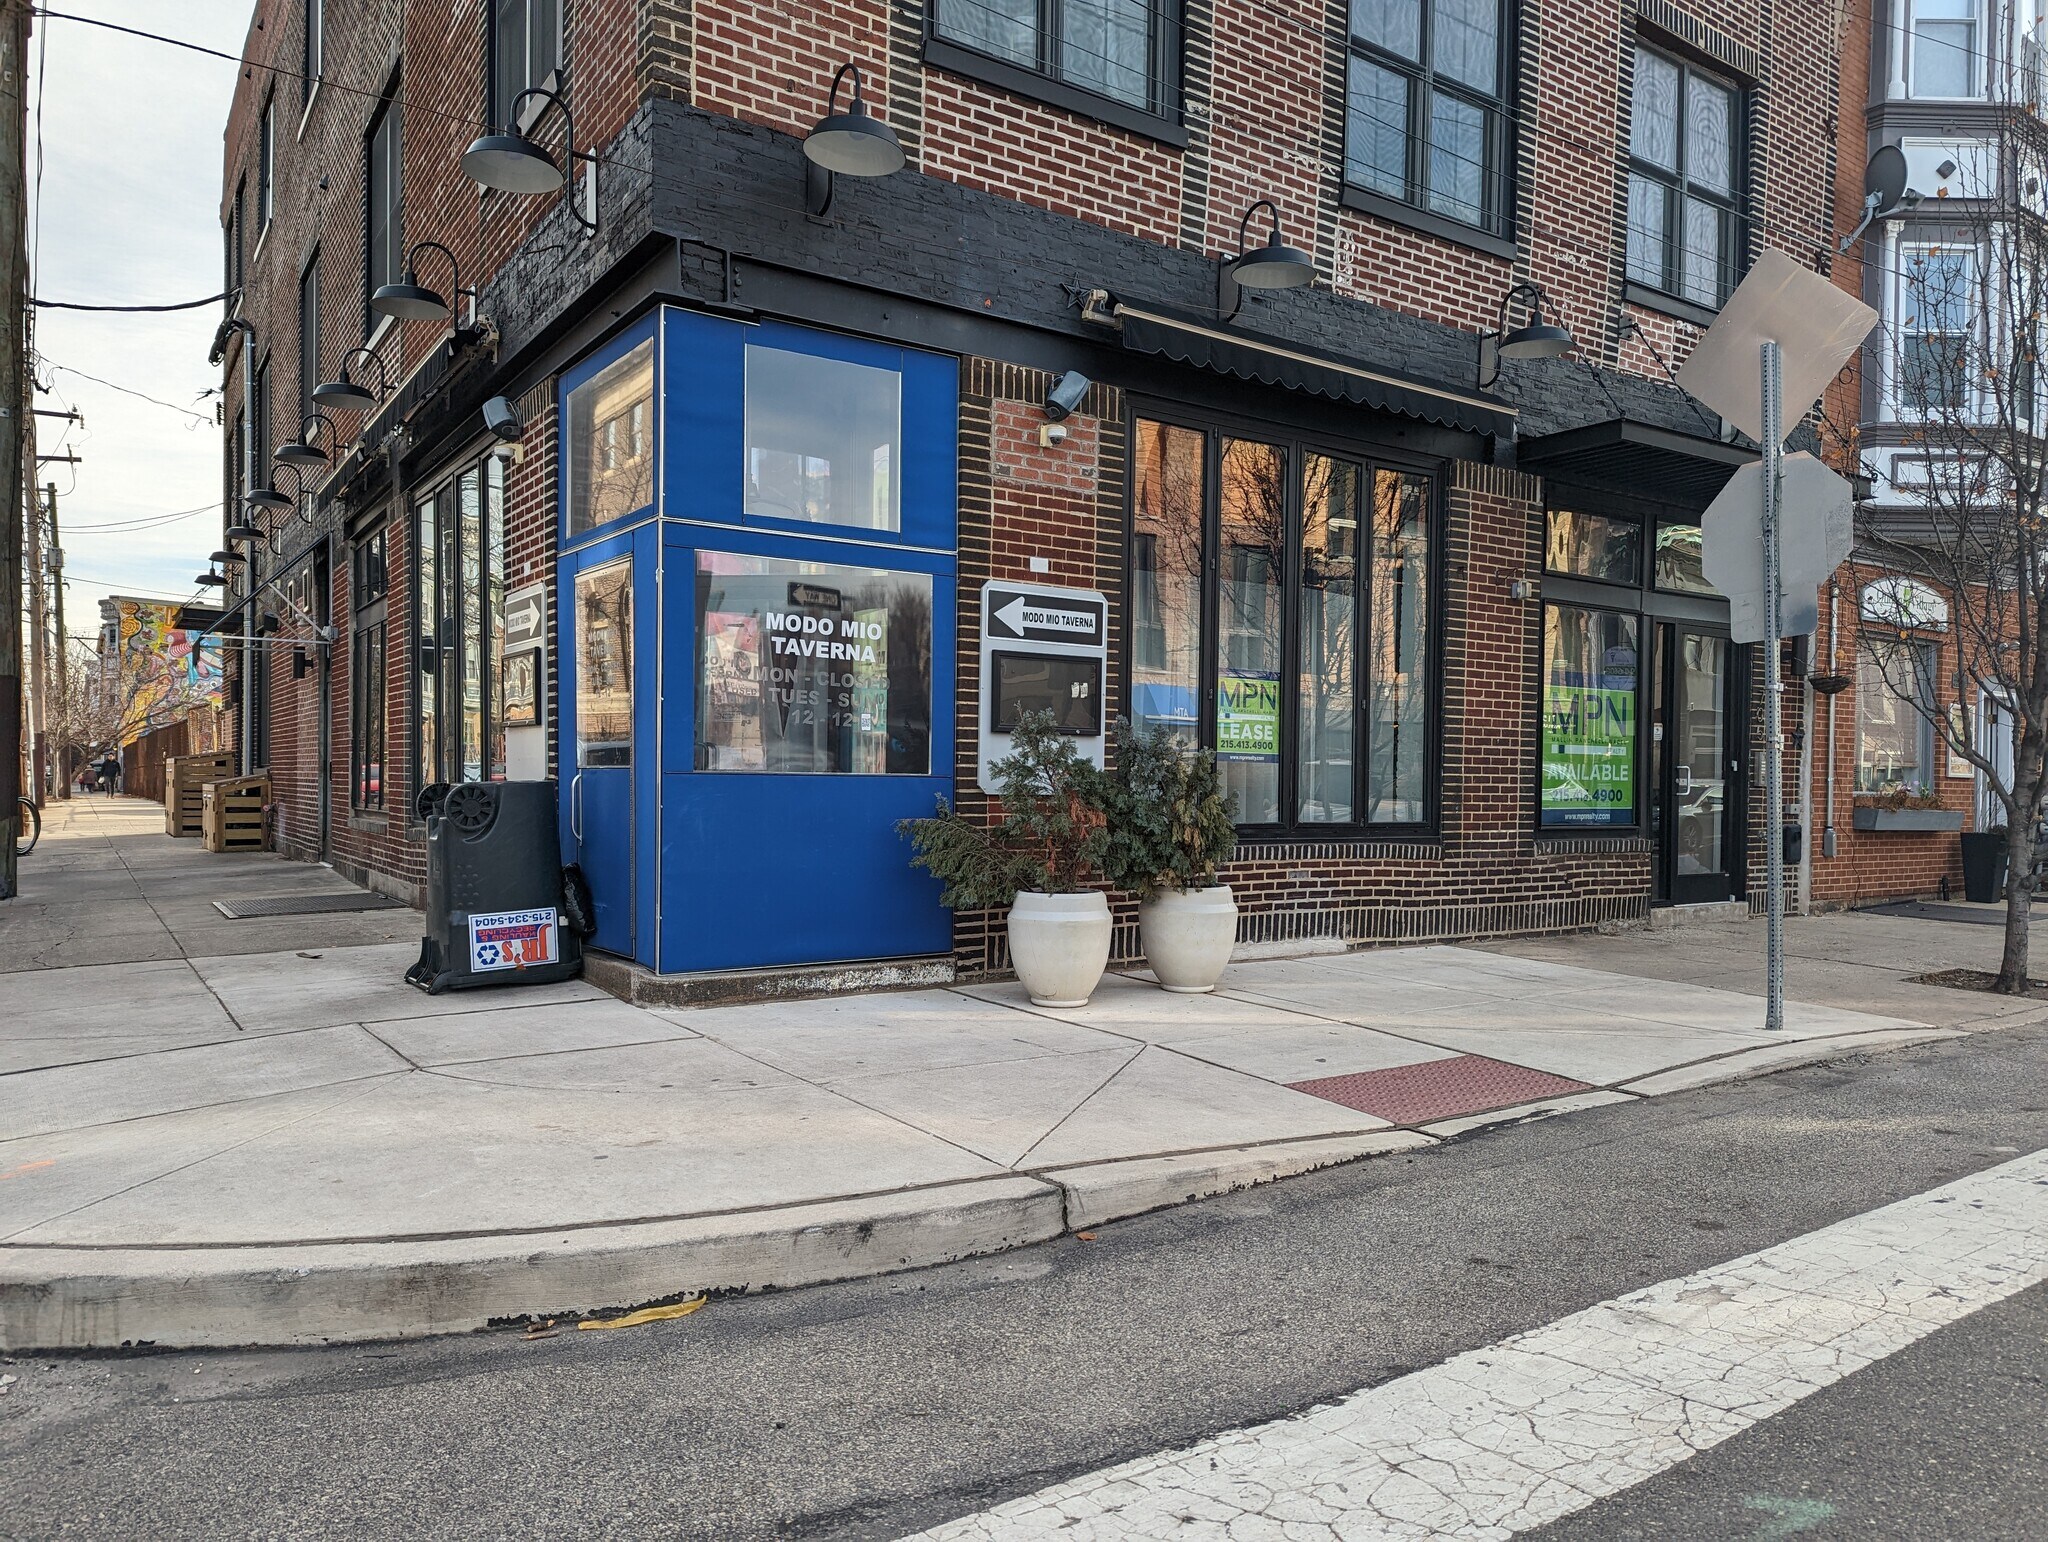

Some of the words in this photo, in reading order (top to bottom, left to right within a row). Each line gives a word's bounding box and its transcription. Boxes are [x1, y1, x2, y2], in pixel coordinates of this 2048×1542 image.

[766, 612, 834, 636] MODO
[841, 620, 882, 640] MIO
[1022, 611, 1044, 624] MODO
[1045, 614, 1060, 625] MIO
[1061, 616, 1094, 629] TAVERNA
[771, 636, 876, 663] TAVERNA
[754, 666, 799, 683] MON
[817, 671, 891, 691] CLOSED
[768, 688, 821, 706] TUES
[838, 692, 875, 710] SUN
[1220, 680, 1277, 710] MPN
[791, 709, 814, 725] 12
[832, 711, 854, 727] 12
[1553, 691, 1627, 737] MPN
[1220, 722, 1274, 741] LEASE
[1220, 740, 1274, 751] 215.413.4900
[1547, 763, 1629, 781] AVAILABLE
[475, 912, 552, 927] 215-334-5404
[478, 925, 536, 936] RECYCLING
[491, 931, 537, 940] HAULING
[502, 923, 553, 963] JR'S
